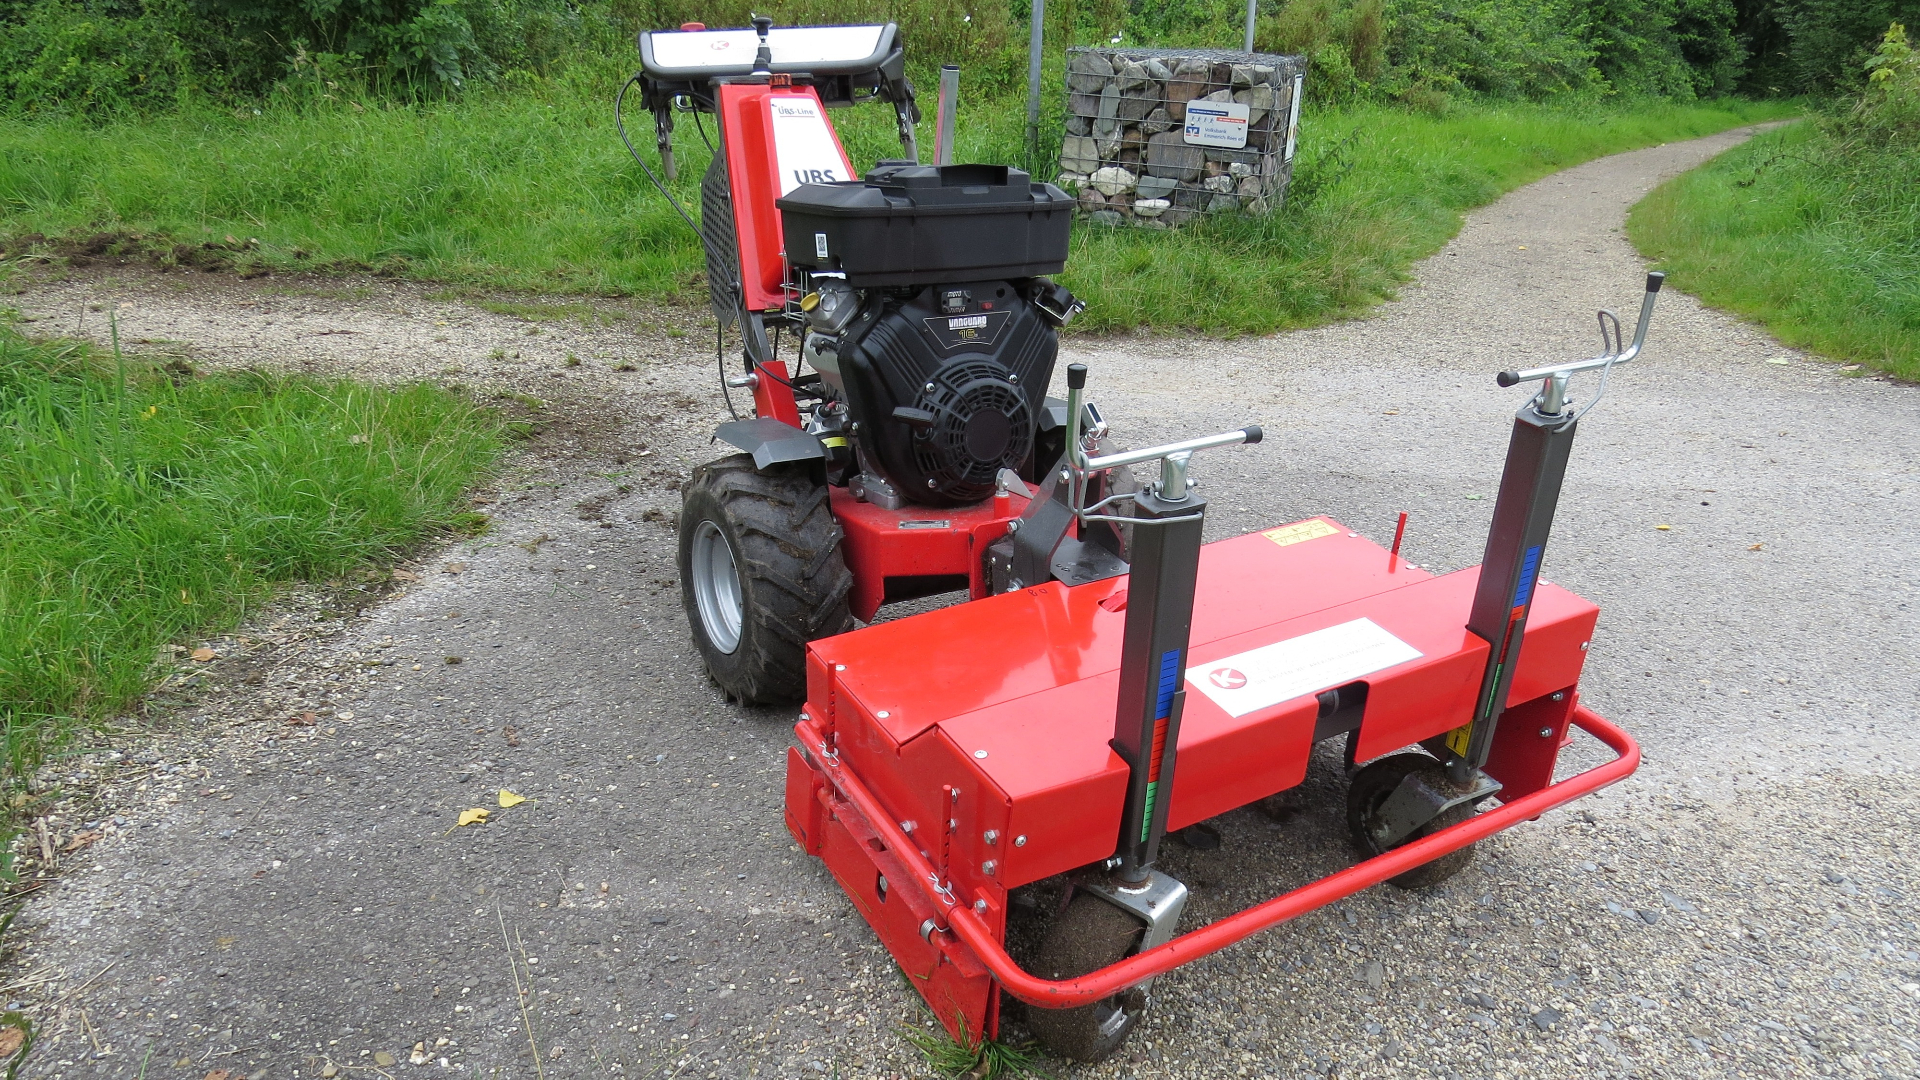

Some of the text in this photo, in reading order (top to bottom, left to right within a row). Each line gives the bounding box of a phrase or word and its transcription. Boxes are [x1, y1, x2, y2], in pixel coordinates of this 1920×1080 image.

[793, 169, 837, 185] UBS
[948, 316, 987, 328] VANGUARD
[958, 328, 975, 339] 16
